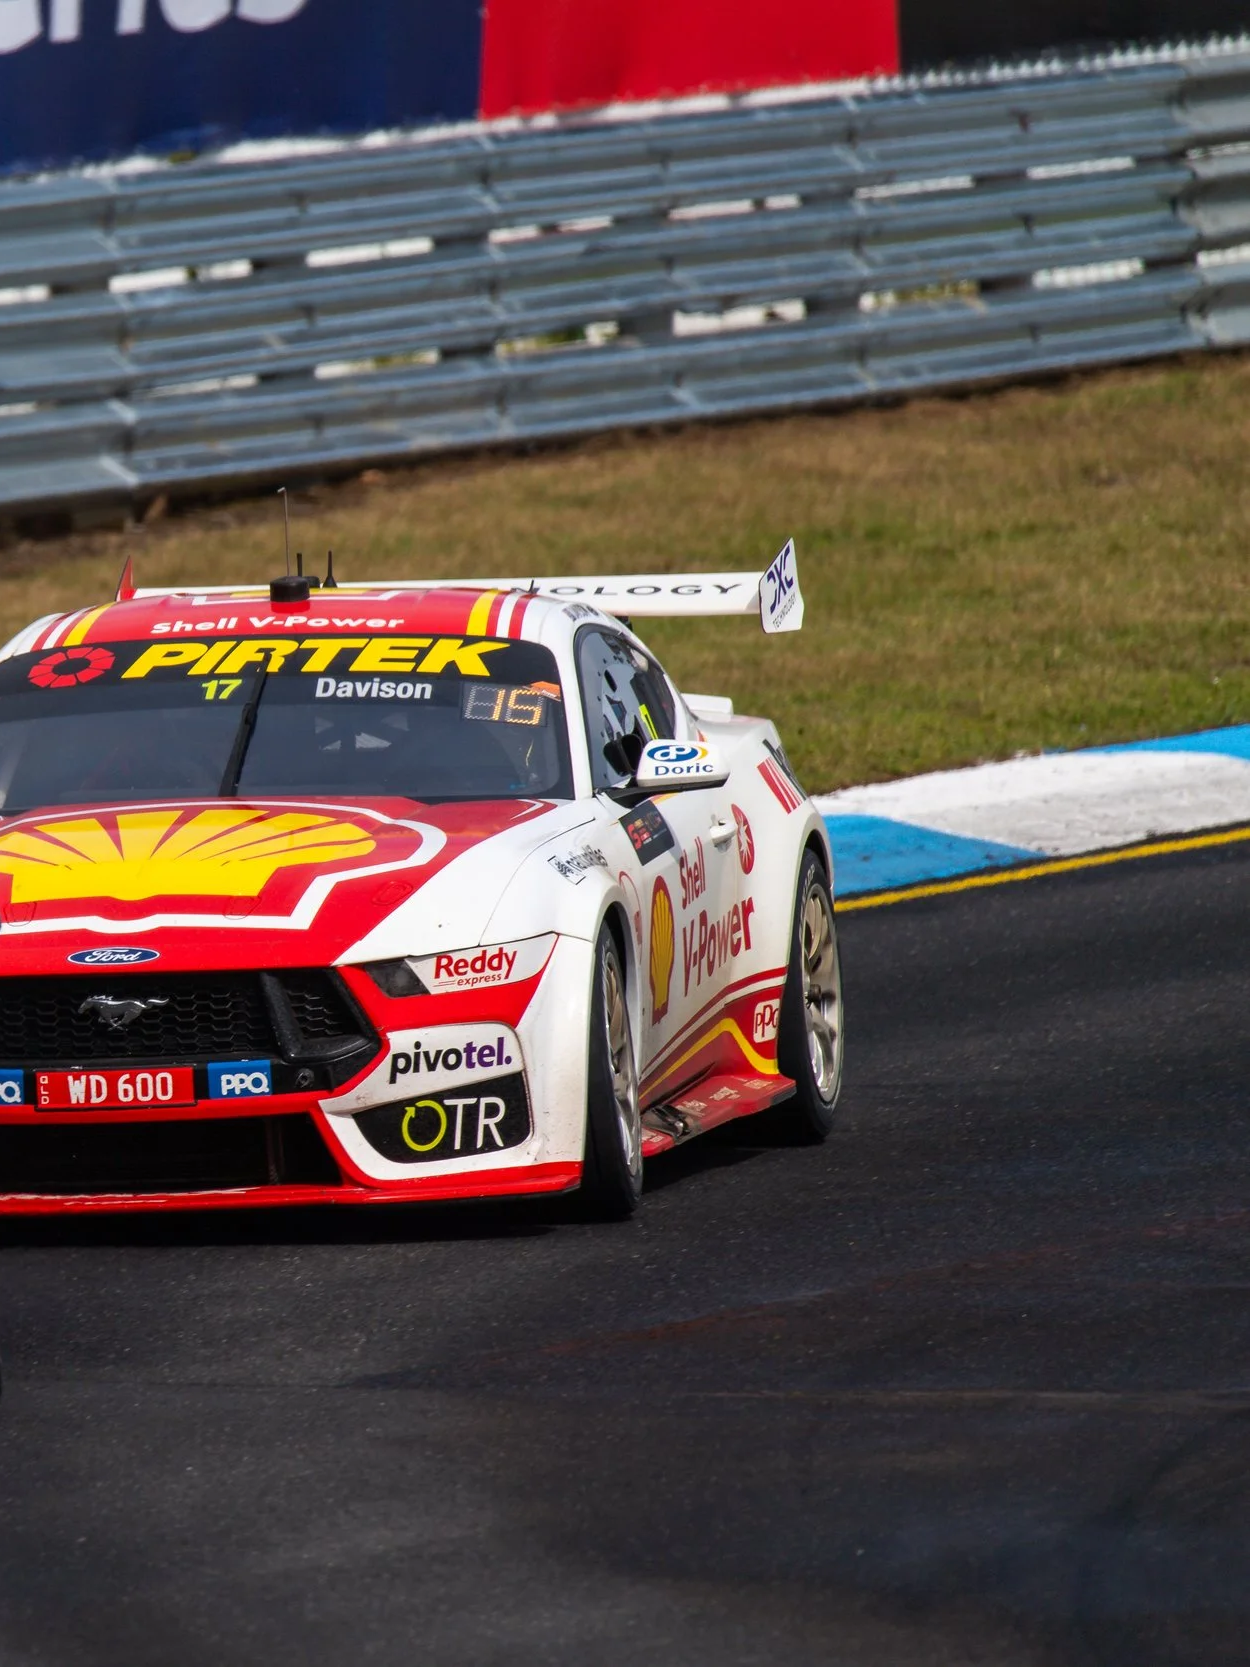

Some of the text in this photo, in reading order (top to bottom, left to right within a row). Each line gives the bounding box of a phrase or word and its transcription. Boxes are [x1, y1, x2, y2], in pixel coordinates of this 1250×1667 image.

[150, 615, 405, 635] Shell V-Power
[121, 637, 511, 679] PIRTEK
[201, 679, 244, 700] 17
[315, 677, 433, 700] Davison
[655, 763, 713, 776] Doric
[679, 836, 706, 910] Shell
[85, 948, 141, 963] Ford
[681, 896, 755, 997] V-Power
[434, 947, 517, 979] Reddy
[457, 973, 502, 988] express
[67, 1071, 174, 1104] WD 600
[220, 1071, 270, 1096] PPQ
